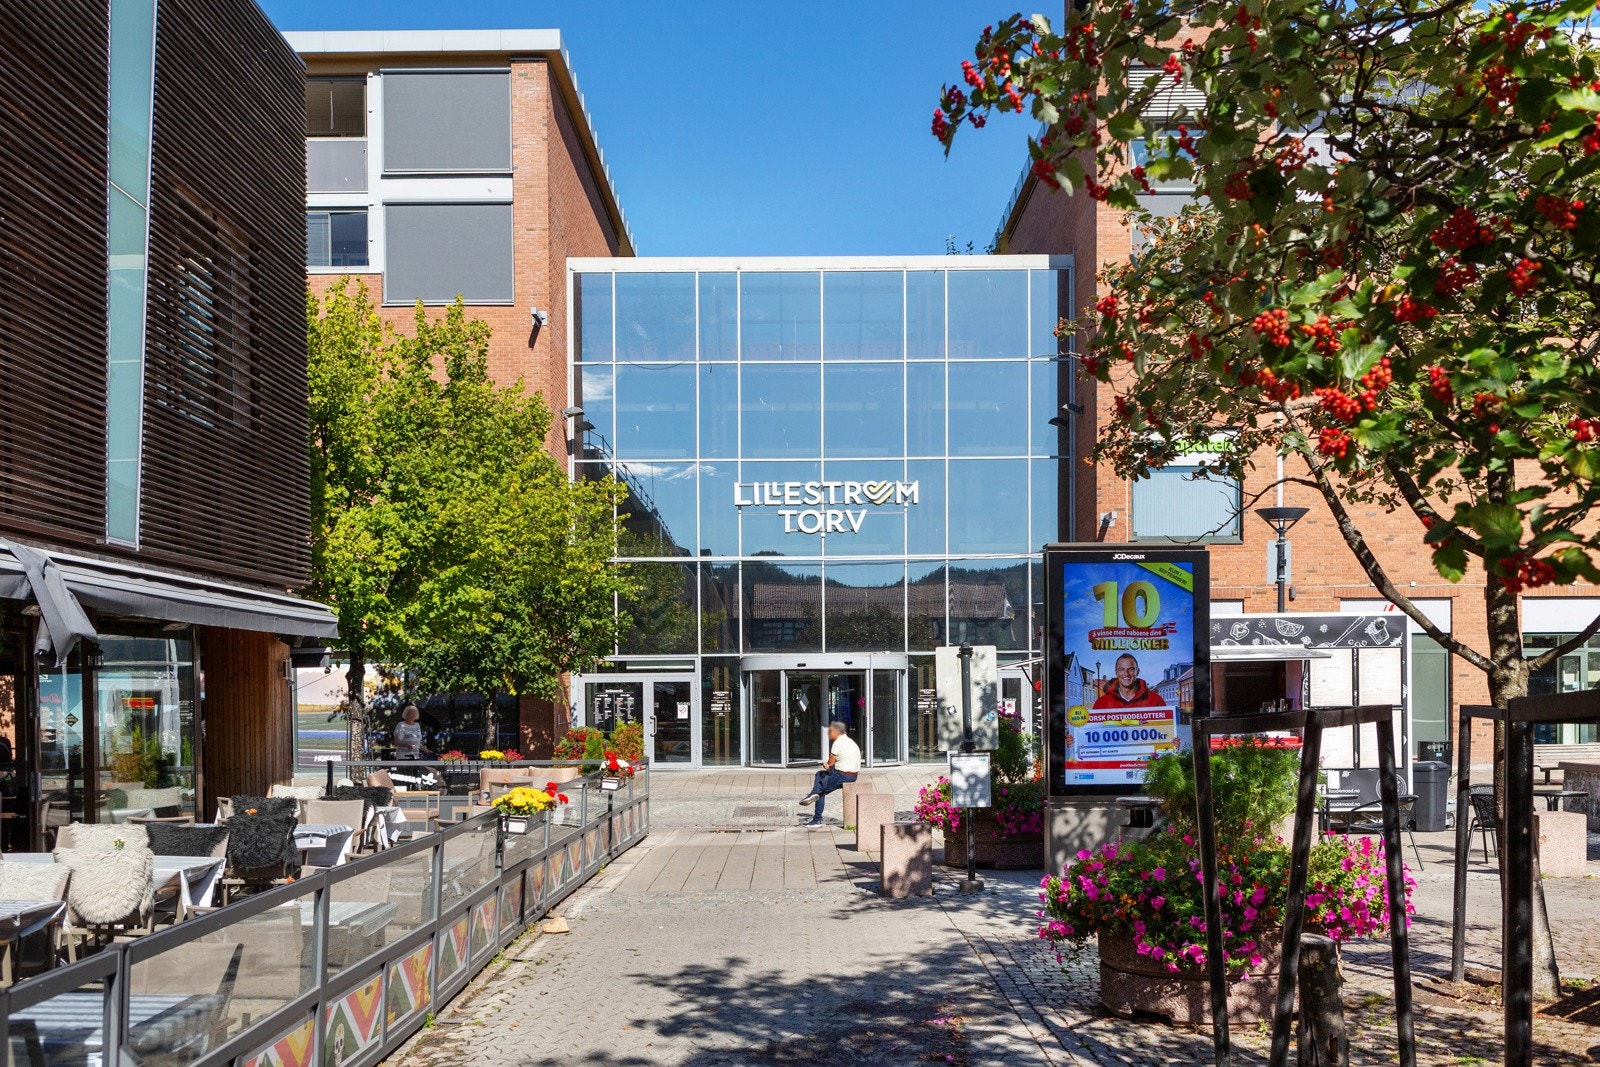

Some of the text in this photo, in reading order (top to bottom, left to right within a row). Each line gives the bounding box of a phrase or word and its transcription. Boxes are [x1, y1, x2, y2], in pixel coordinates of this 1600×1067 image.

[778, 509, 868, 534] TORV
[1092, 580, 1161, 629] 10
[1092, 638, 1169, 650] MILLIONER
[1107, 712, 1166, 720] POSTKODELOTTERI
[1084, 731, 1100, 743] 10
[1102, 730, 1129, 742] 000
